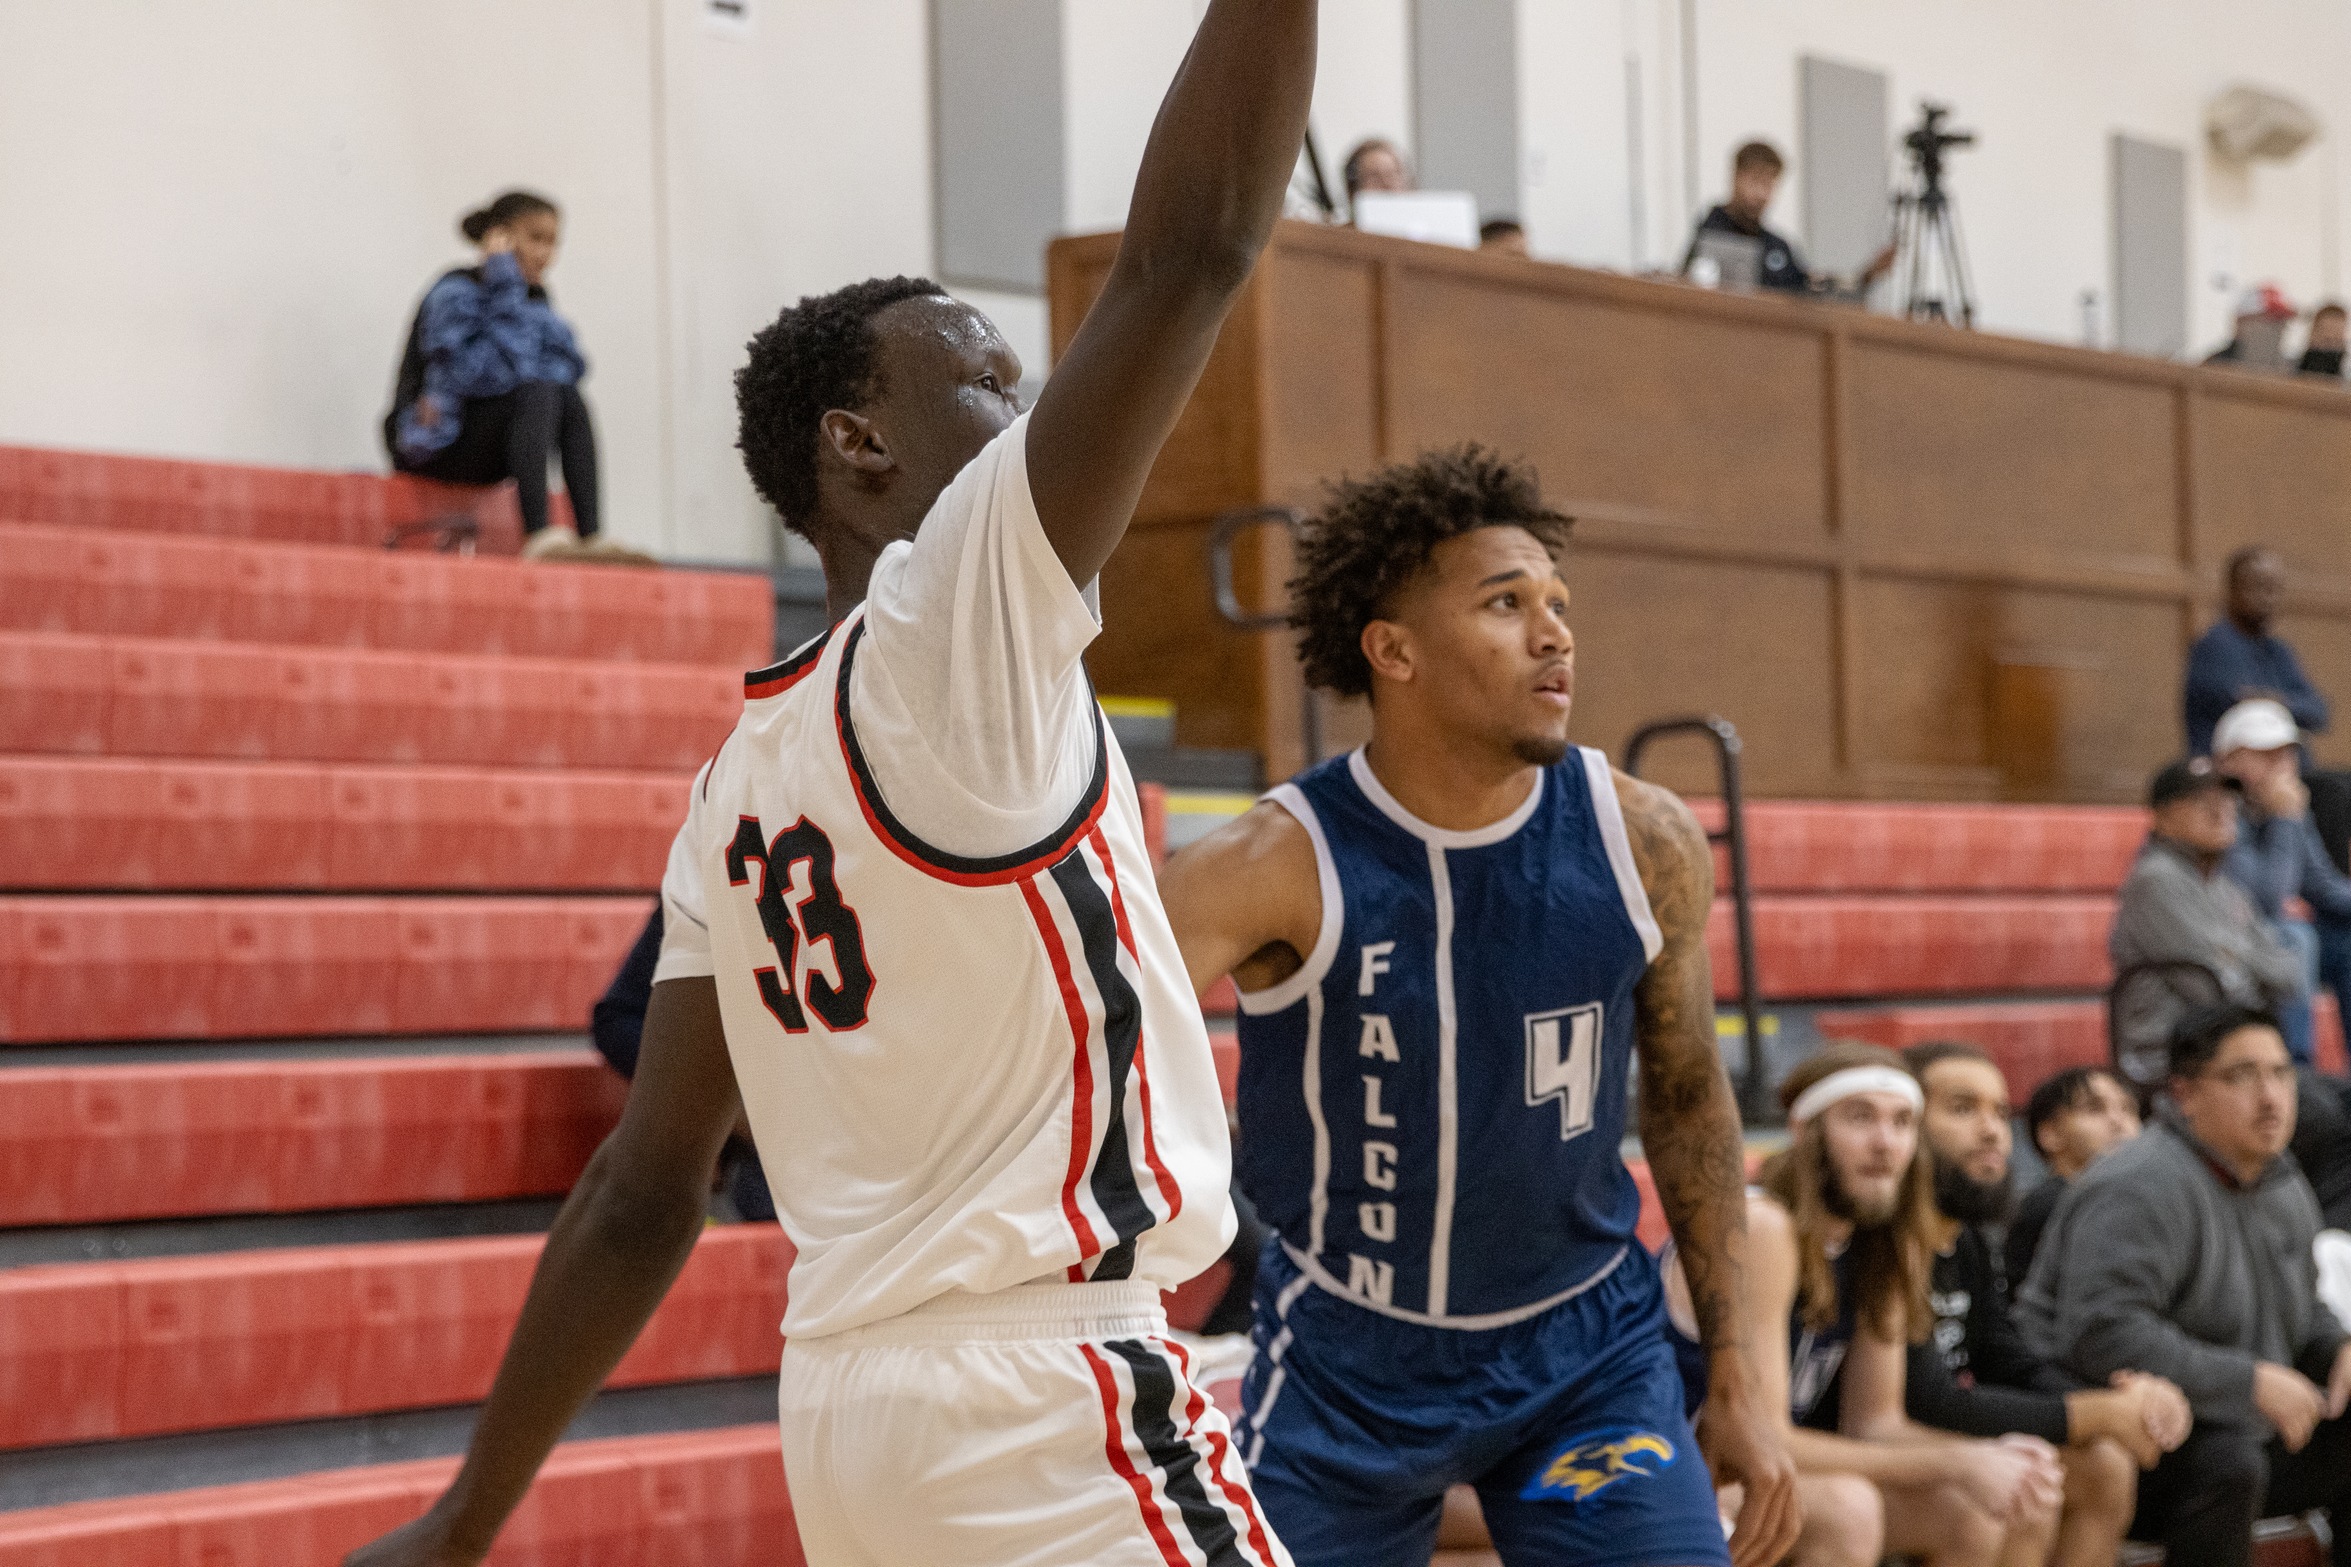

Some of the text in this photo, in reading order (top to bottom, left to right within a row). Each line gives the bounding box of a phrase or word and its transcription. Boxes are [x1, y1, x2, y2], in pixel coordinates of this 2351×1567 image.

[725, 814, 877, 1034] 33
[1348, 941, 1400, 1307] FALCON
[1524, 1001, 1604, 1142] 4
